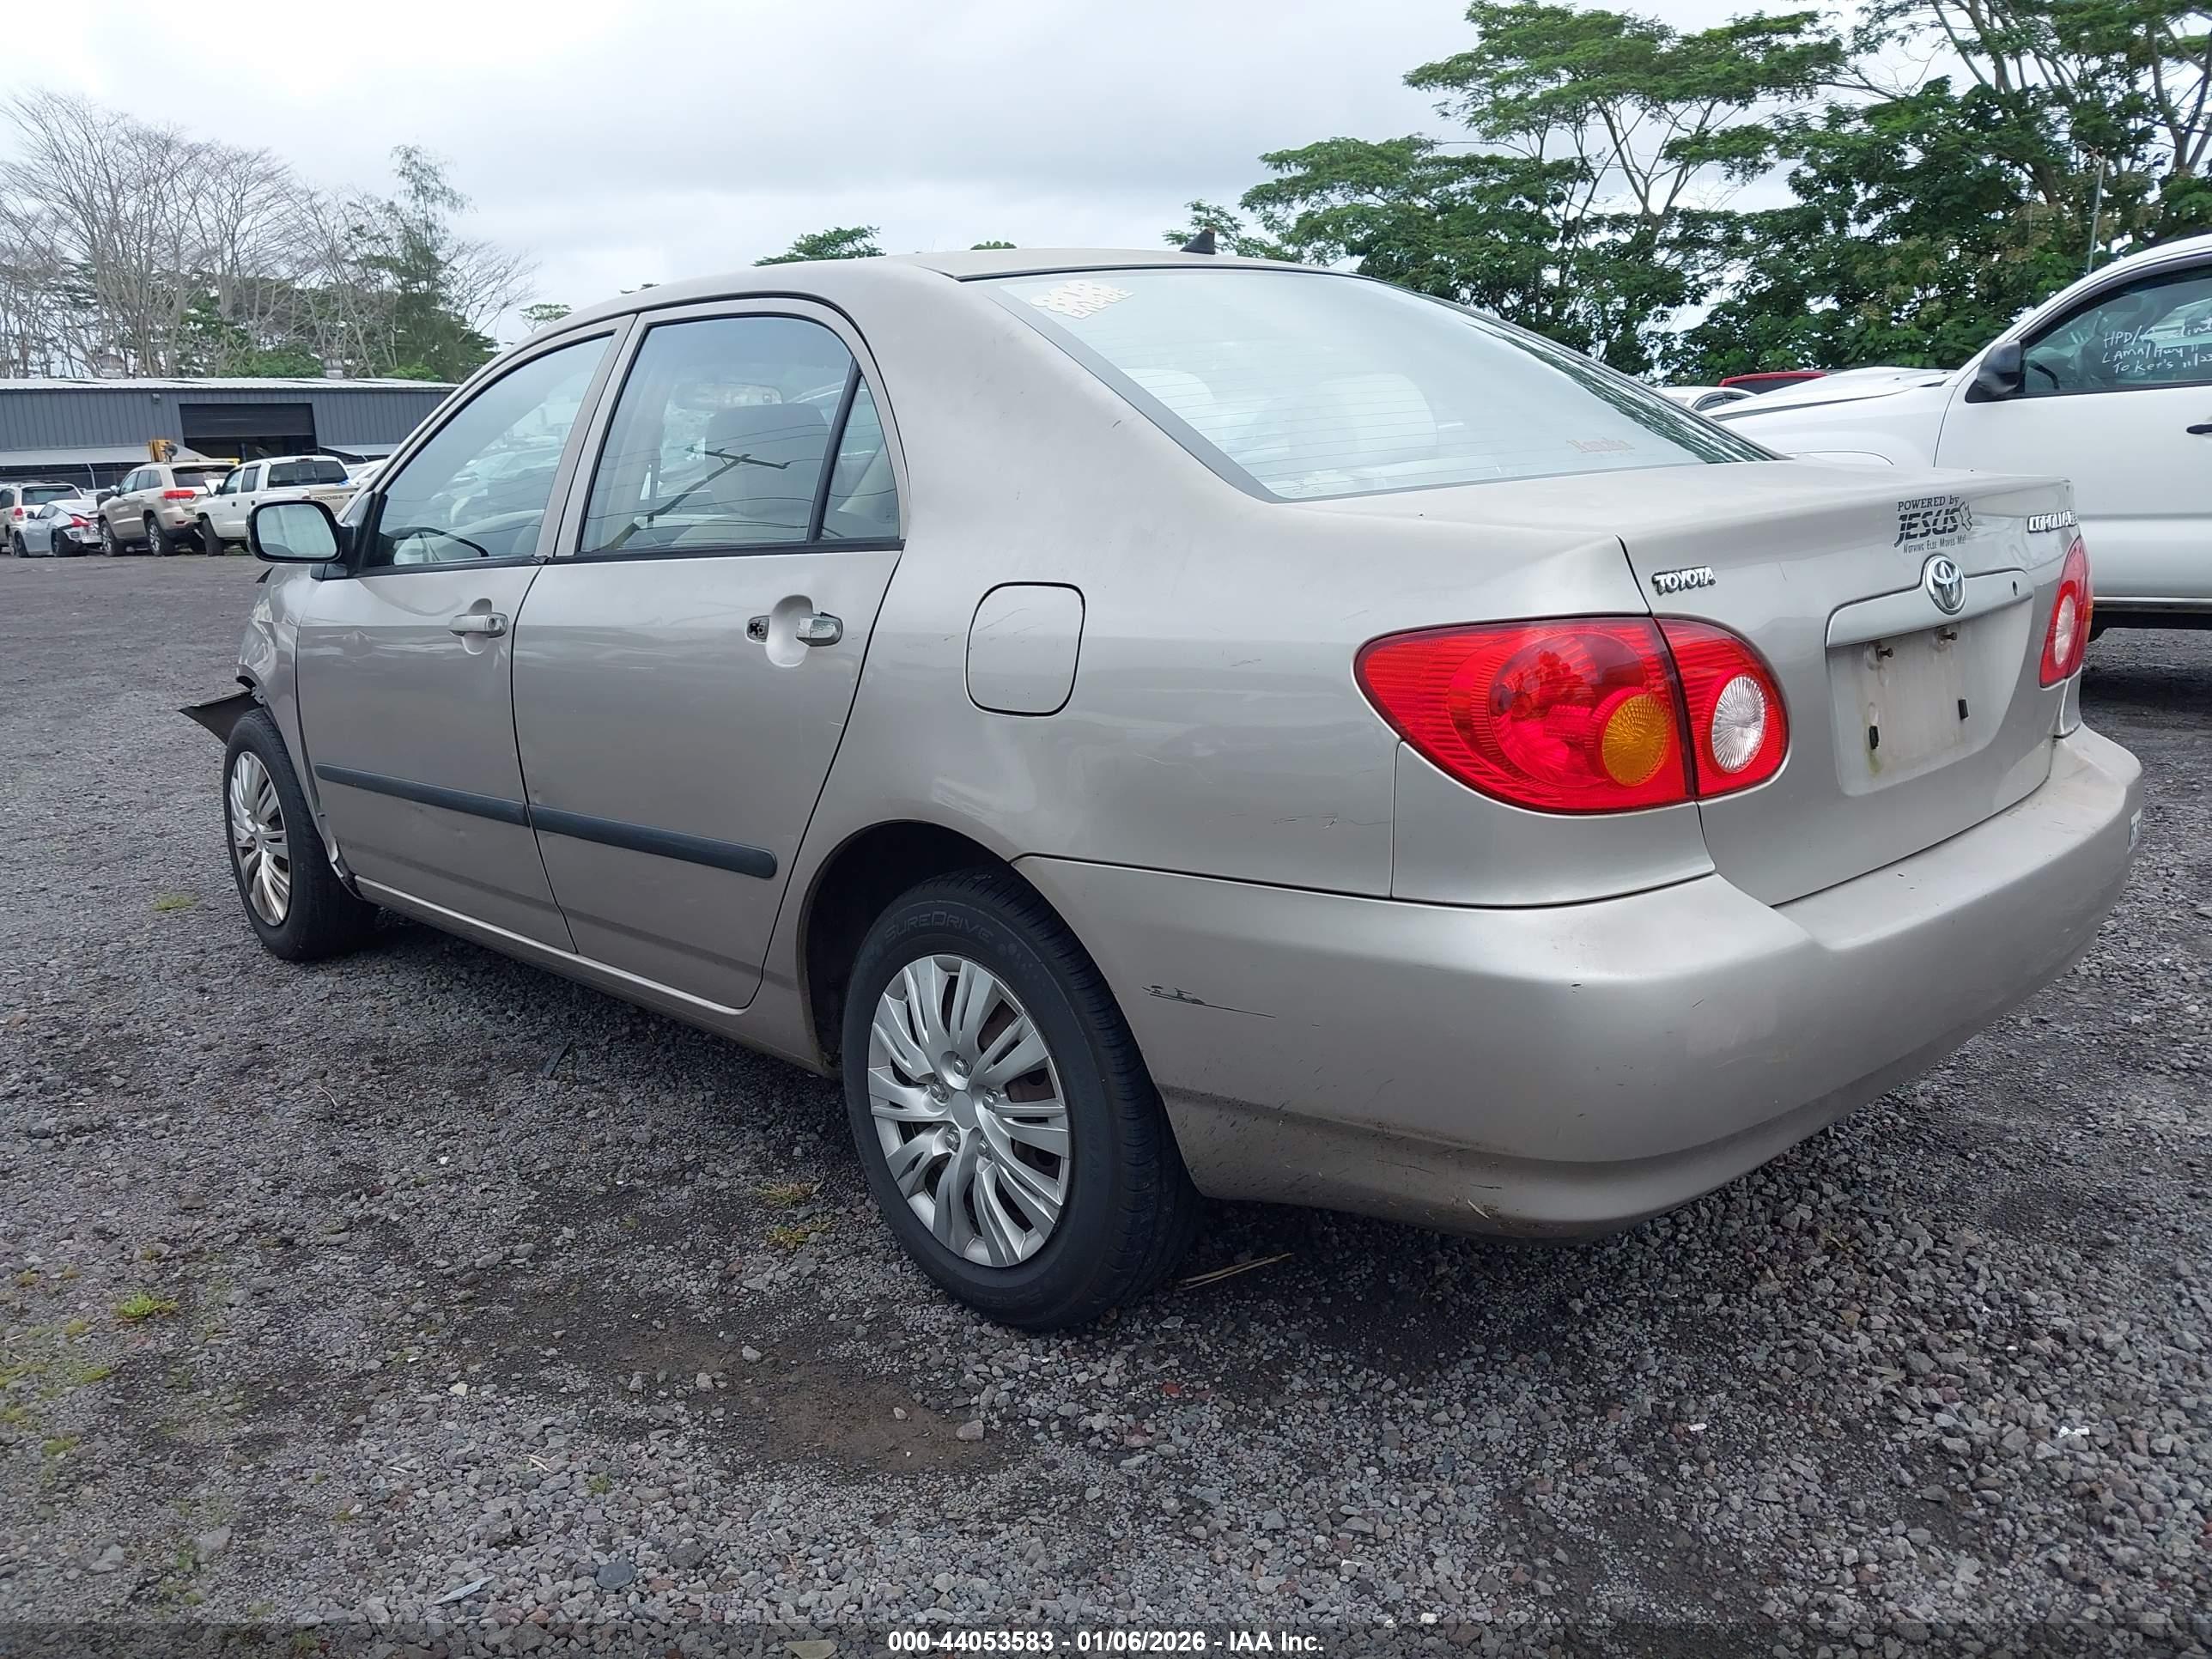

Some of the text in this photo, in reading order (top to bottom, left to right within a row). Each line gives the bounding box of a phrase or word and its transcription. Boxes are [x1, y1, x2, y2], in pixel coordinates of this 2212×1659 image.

[1898, 495, 1960, 512] POWERED by
[1893, 507, 1961, 548] JESUS
[1651, 566, 1717, 596] TOYOTA
